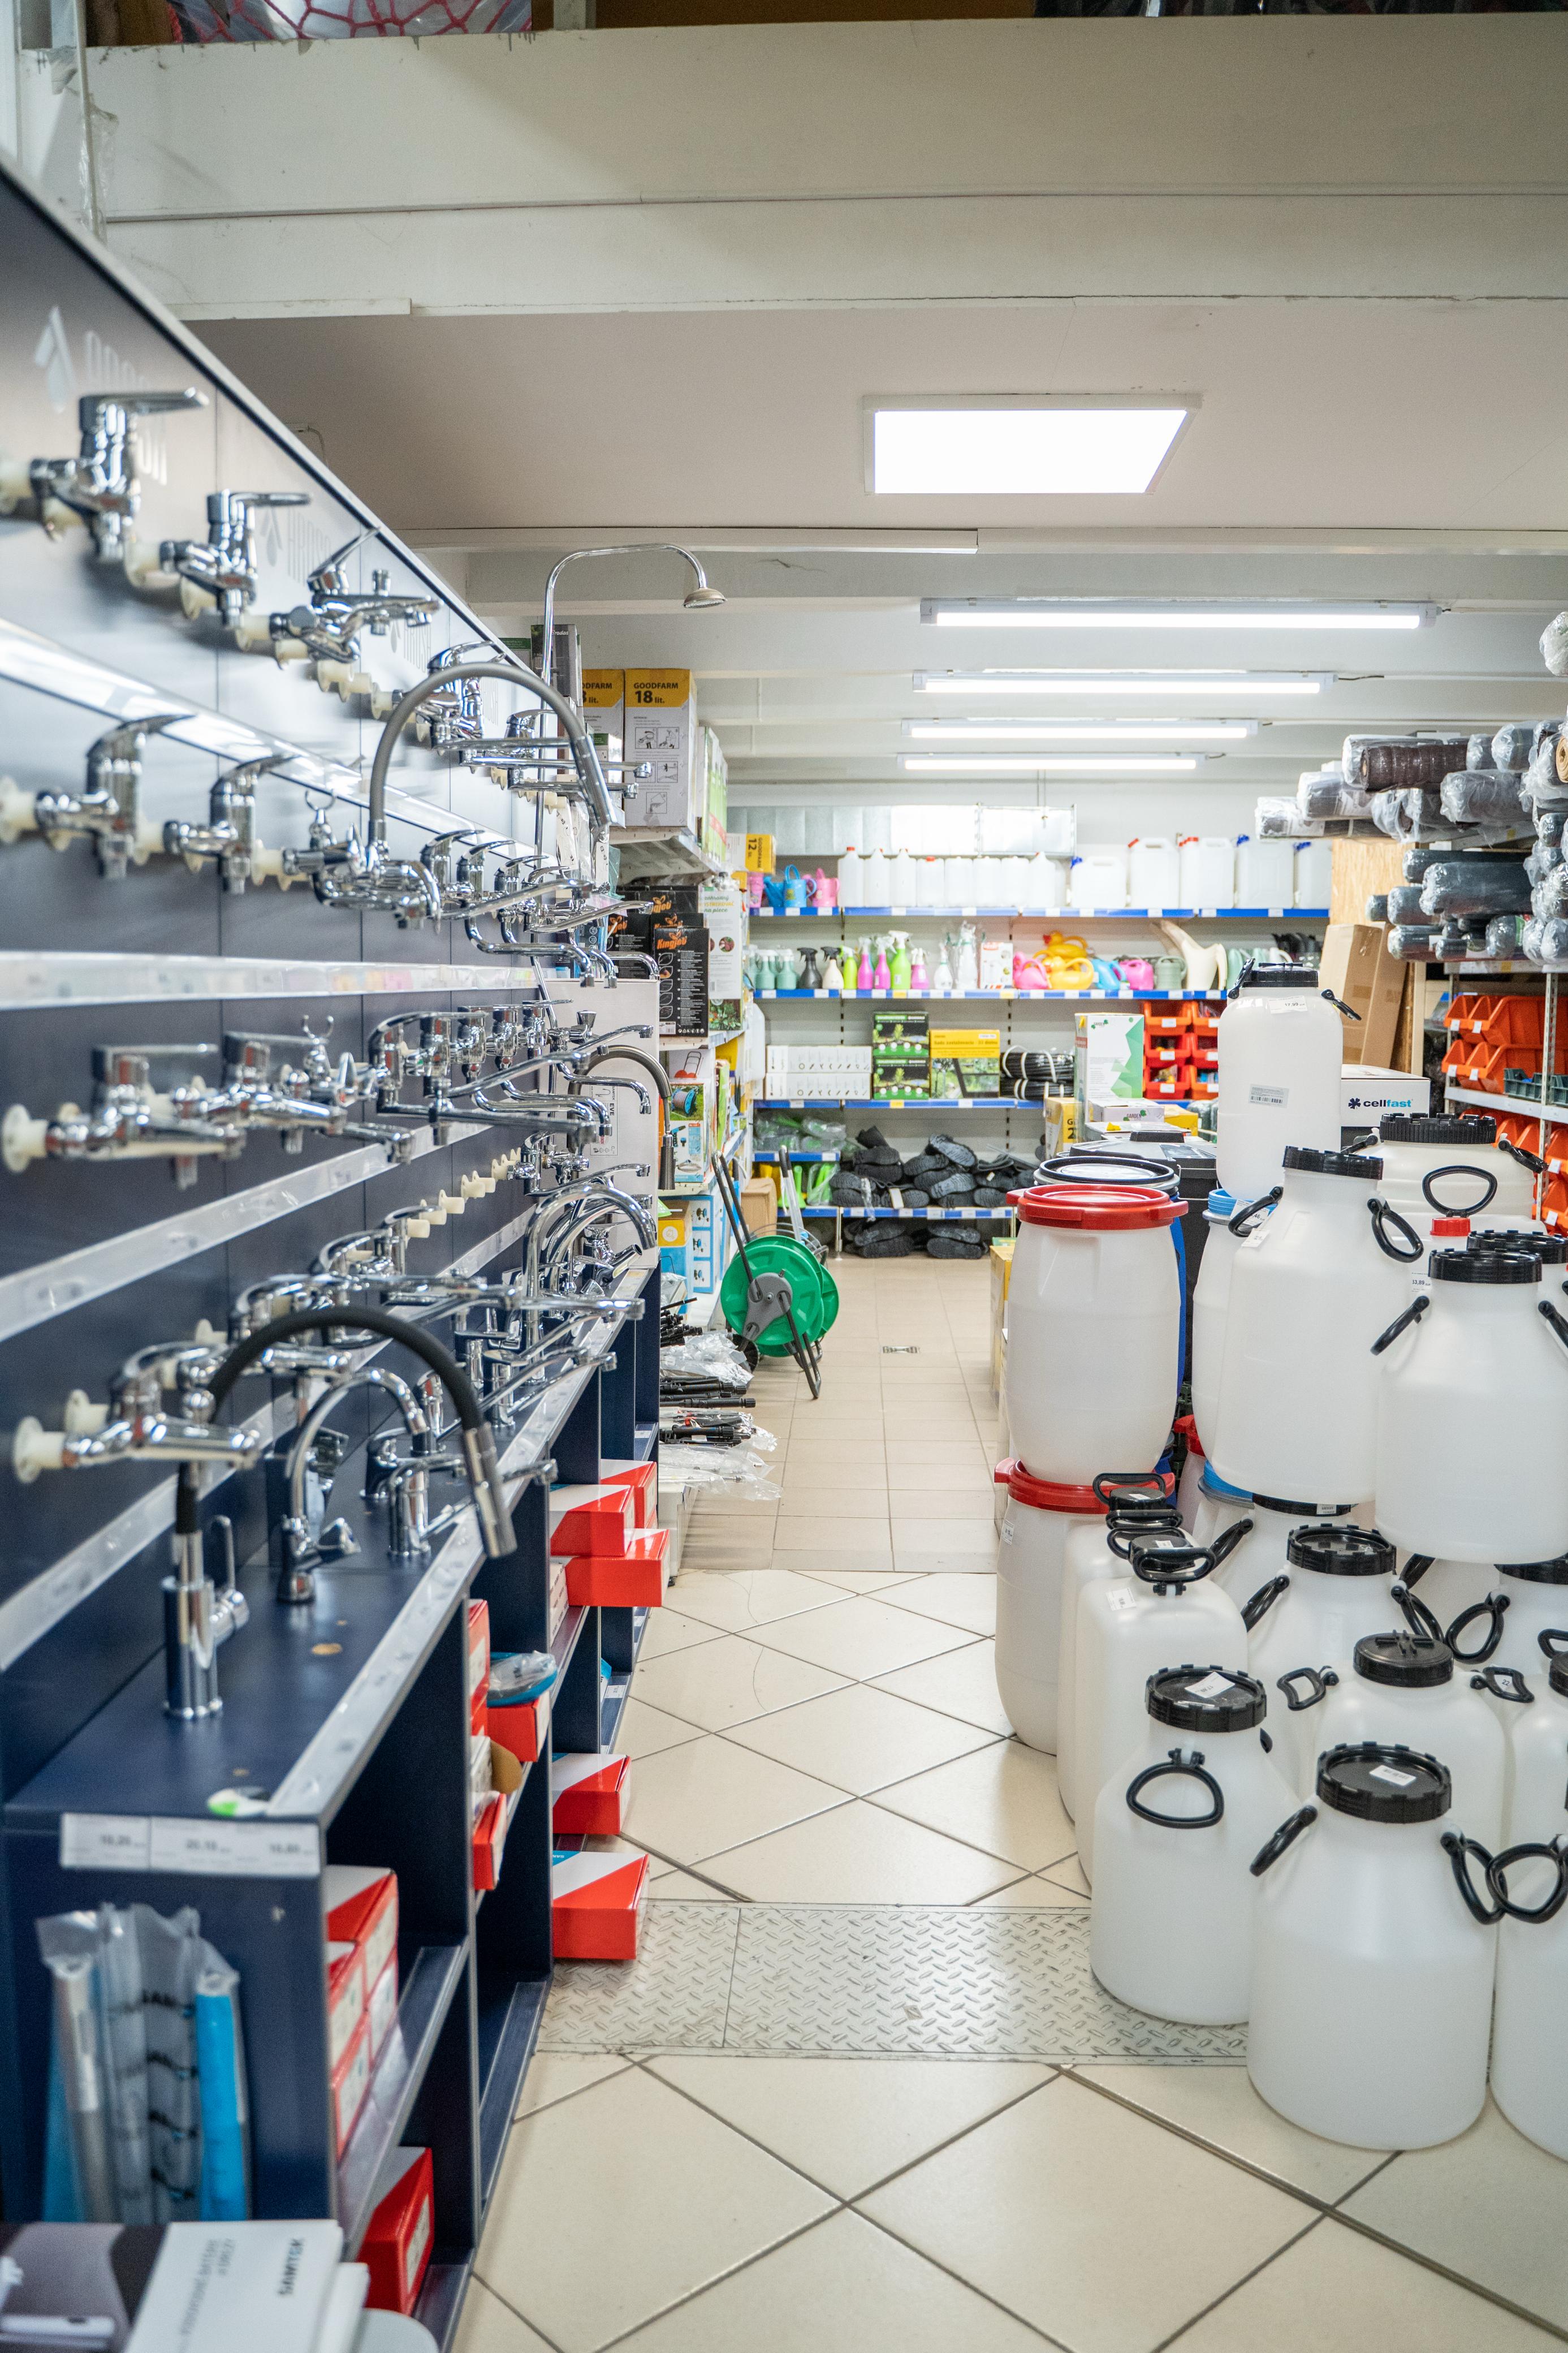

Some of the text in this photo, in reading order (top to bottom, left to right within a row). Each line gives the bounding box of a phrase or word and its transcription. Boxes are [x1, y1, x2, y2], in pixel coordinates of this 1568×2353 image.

[635, 690, 653, 704] 18
[748, 838, 757, 850] 12
[1363, 1099, 1411, 1107] cellfast
